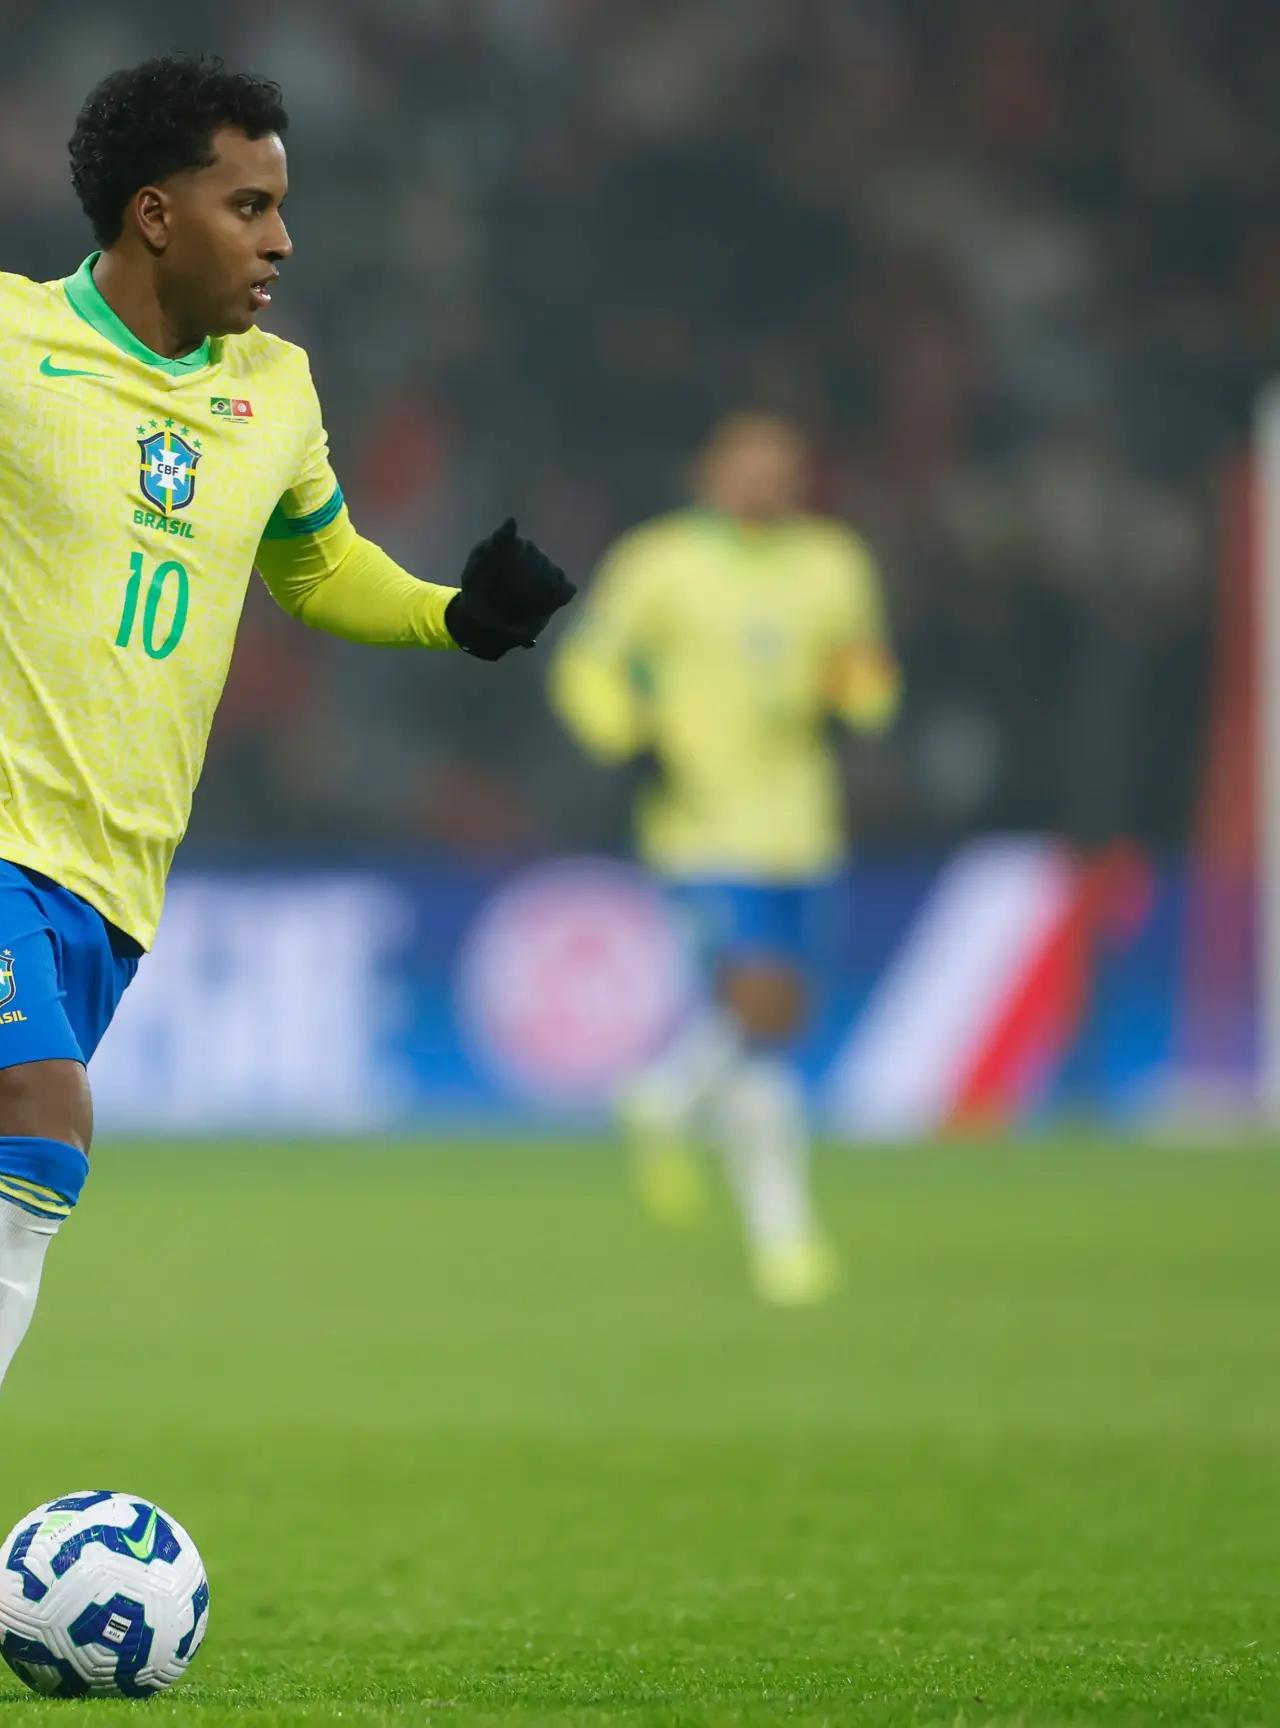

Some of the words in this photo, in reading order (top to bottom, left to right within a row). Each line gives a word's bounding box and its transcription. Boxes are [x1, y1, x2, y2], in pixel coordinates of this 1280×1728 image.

[157, 463, 180, 476] CBF
[133, 509, 194, 538] BRASIL
[115, 551, 189, 660] 10
